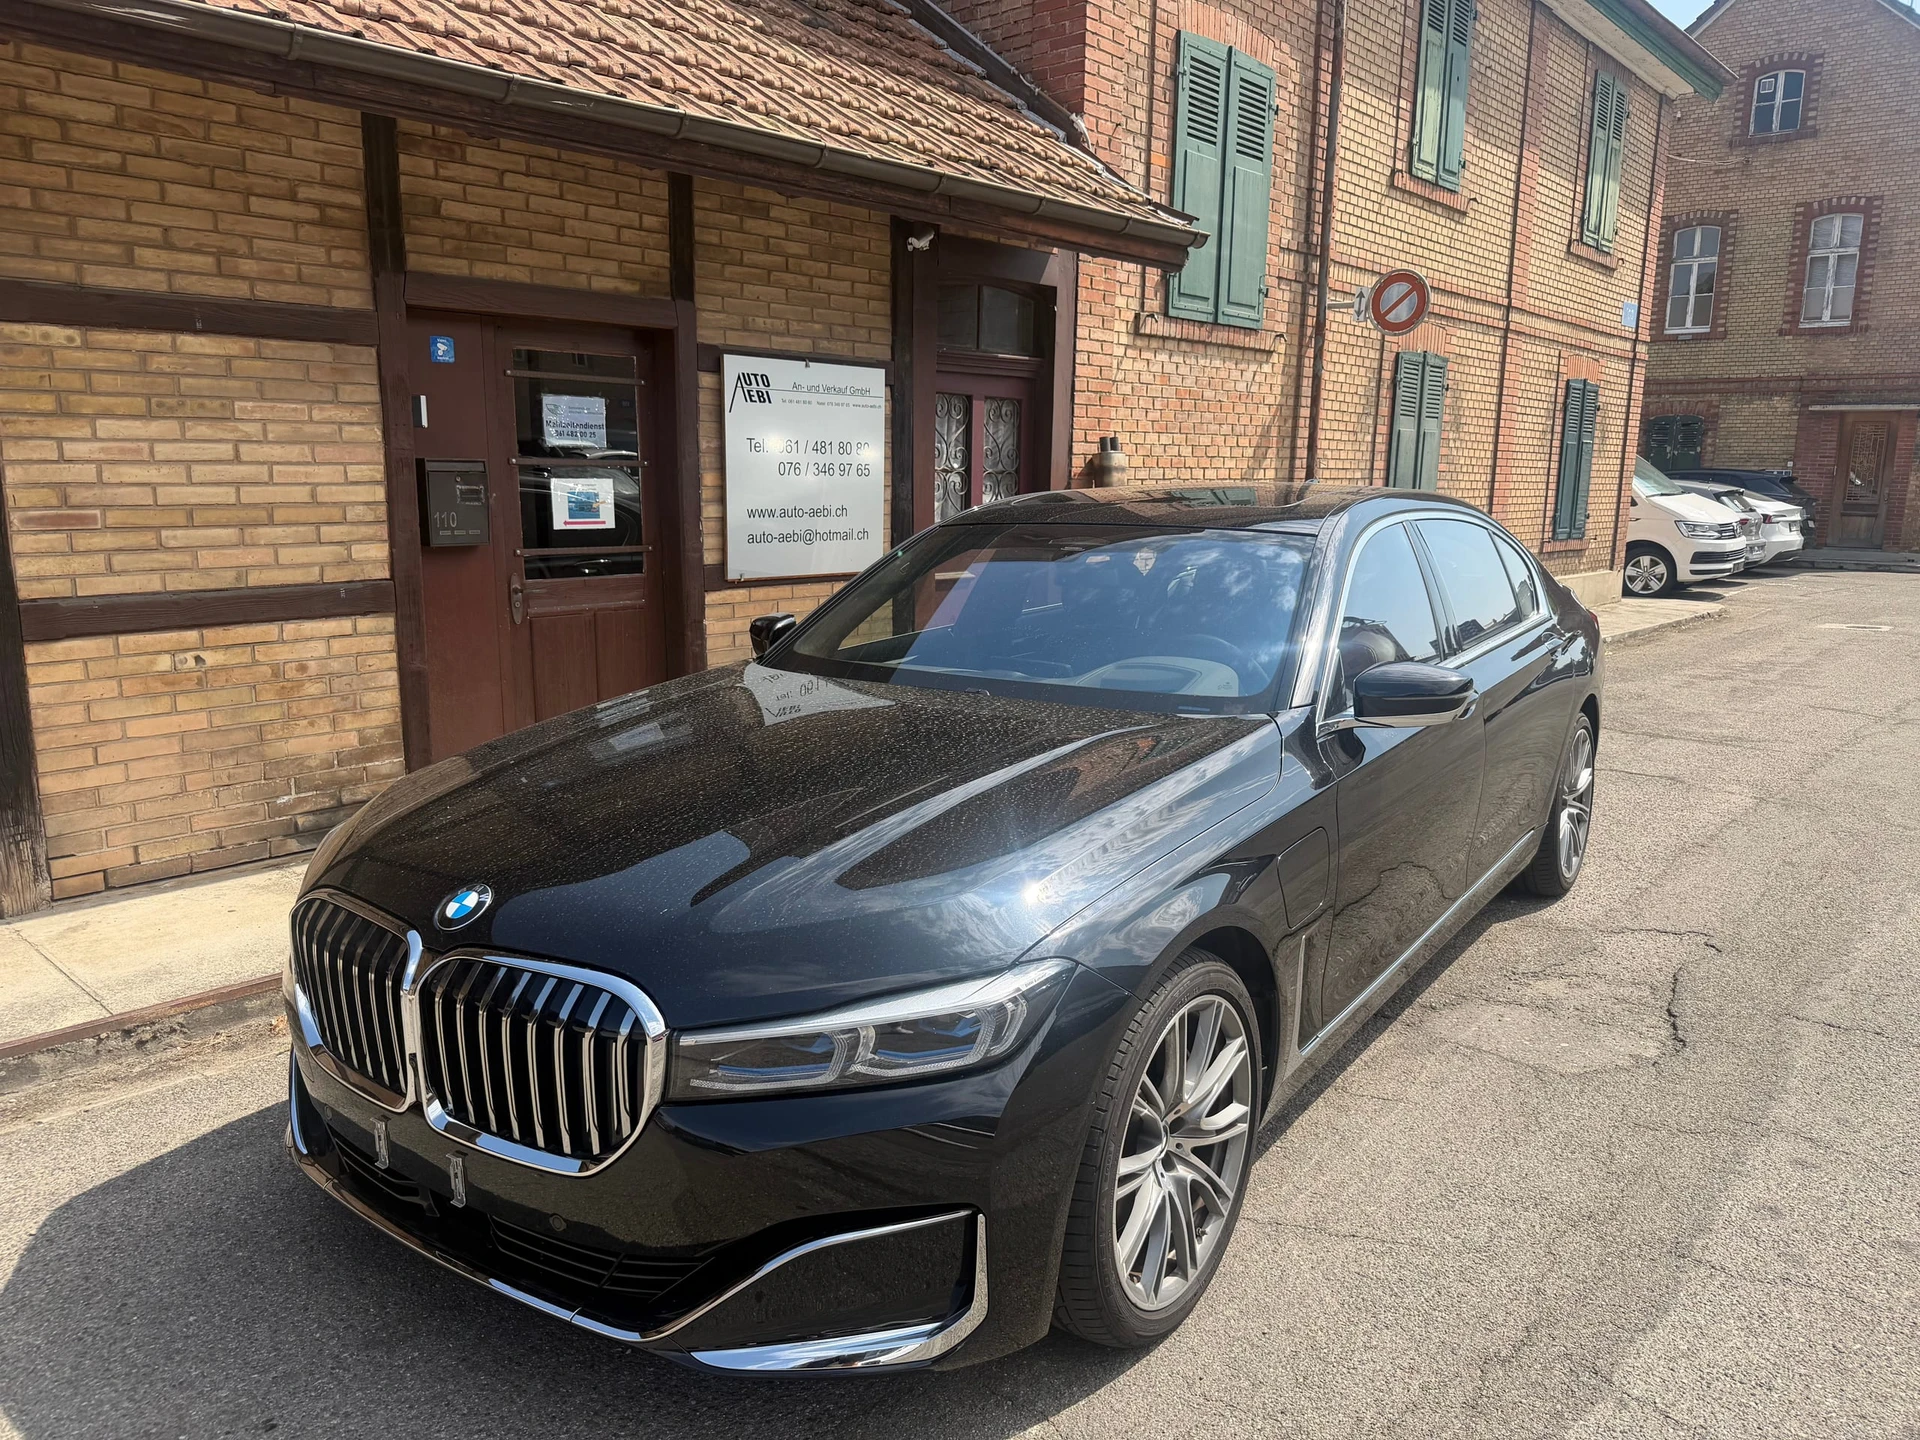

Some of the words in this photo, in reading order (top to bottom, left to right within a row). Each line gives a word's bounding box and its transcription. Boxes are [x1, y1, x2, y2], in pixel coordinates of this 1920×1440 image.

[792, 381, 805, 391] An-
[807, 383, 820, 392] und
[821, 384, 848, 394] Verkauf
[850, 386, 871, 396] GmbH
[746, 437, 769, 453] Tel.
[812, 440, 833, 456] 481
[838, 441, 853, 456] 80
[778, 461, 801, 476] 076
[812, 462, 835, 477] 346
[838, 463, 853, 477] 97
[856, 463, 871, 477] 65
[434, 511, 457, 528] 110
[747, 504, 848, 519] www.auto-aebi.ch
[747, 528, 869, 546] auto-aebi@hotmail.ch
